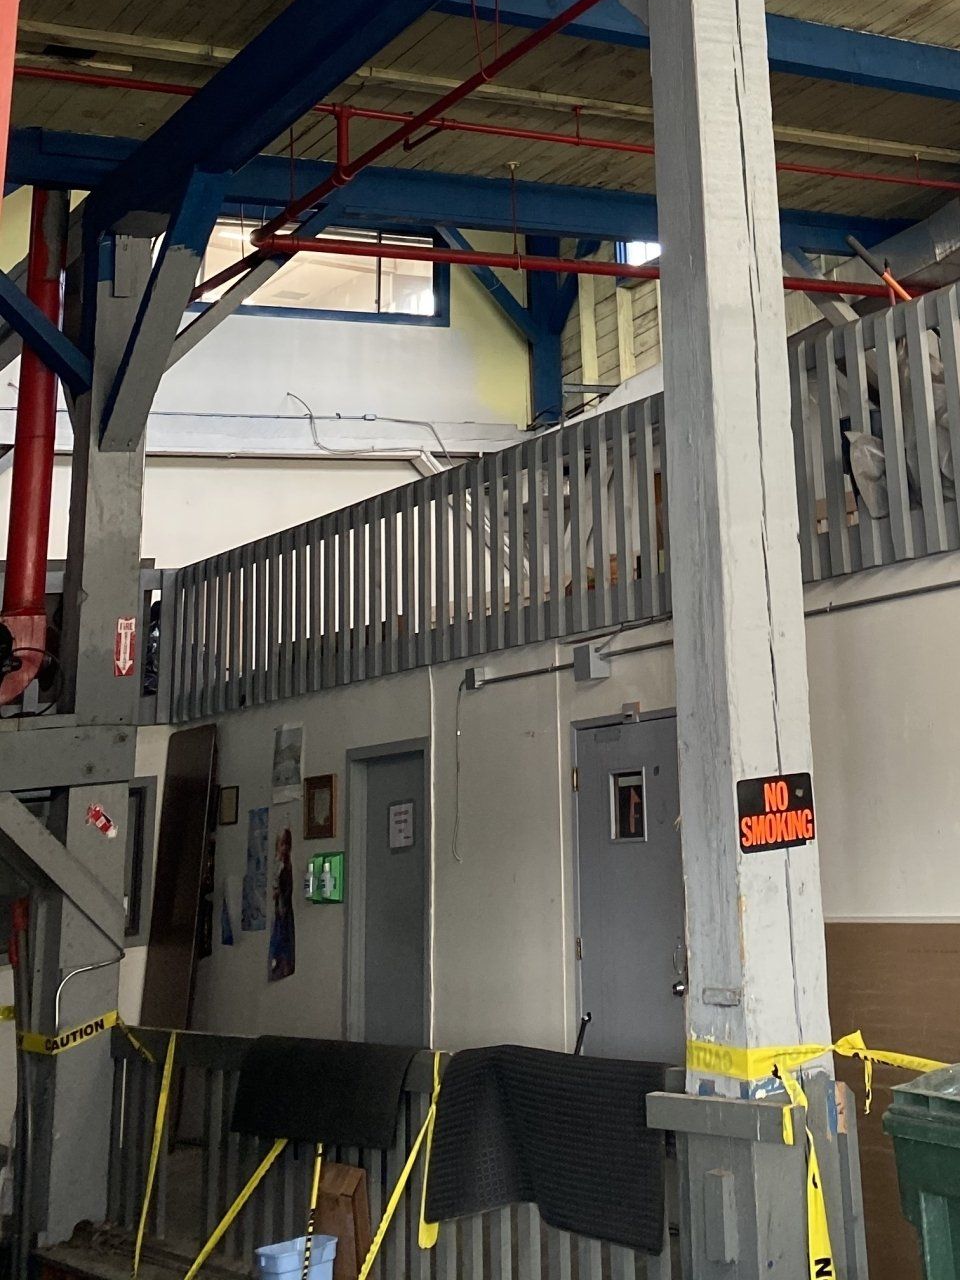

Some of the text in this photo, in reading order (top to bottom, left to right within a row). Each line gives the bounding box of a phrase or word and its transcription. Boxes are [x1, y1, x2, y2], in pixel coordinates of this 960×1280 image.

[763, 781, 789, 812] NO
[741, 809, 813, 847] SMOKING
[44, 1018, 105, 1052] CAUTION
